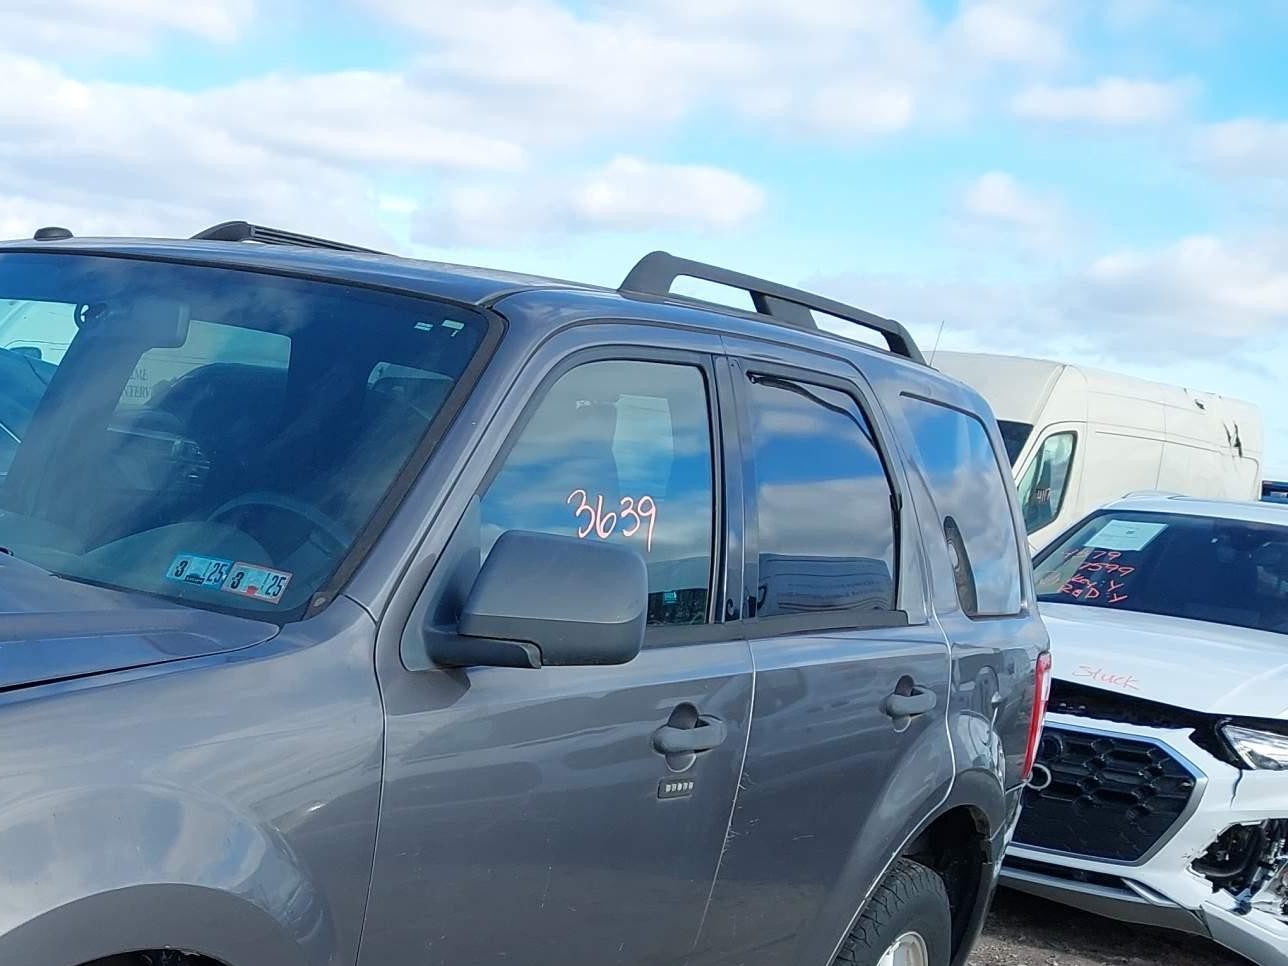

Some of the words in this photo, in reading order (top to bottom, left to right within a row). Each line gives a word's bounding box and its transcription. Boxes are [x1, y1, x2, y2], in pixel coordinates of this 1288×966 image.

[567, 489, 656, 552] 3639
[174, 560, 188, 577] 3
[206, 562, 228, 583] 25
[230, 571, 244, 589] 3
[265, 575, 287, 597] 25
